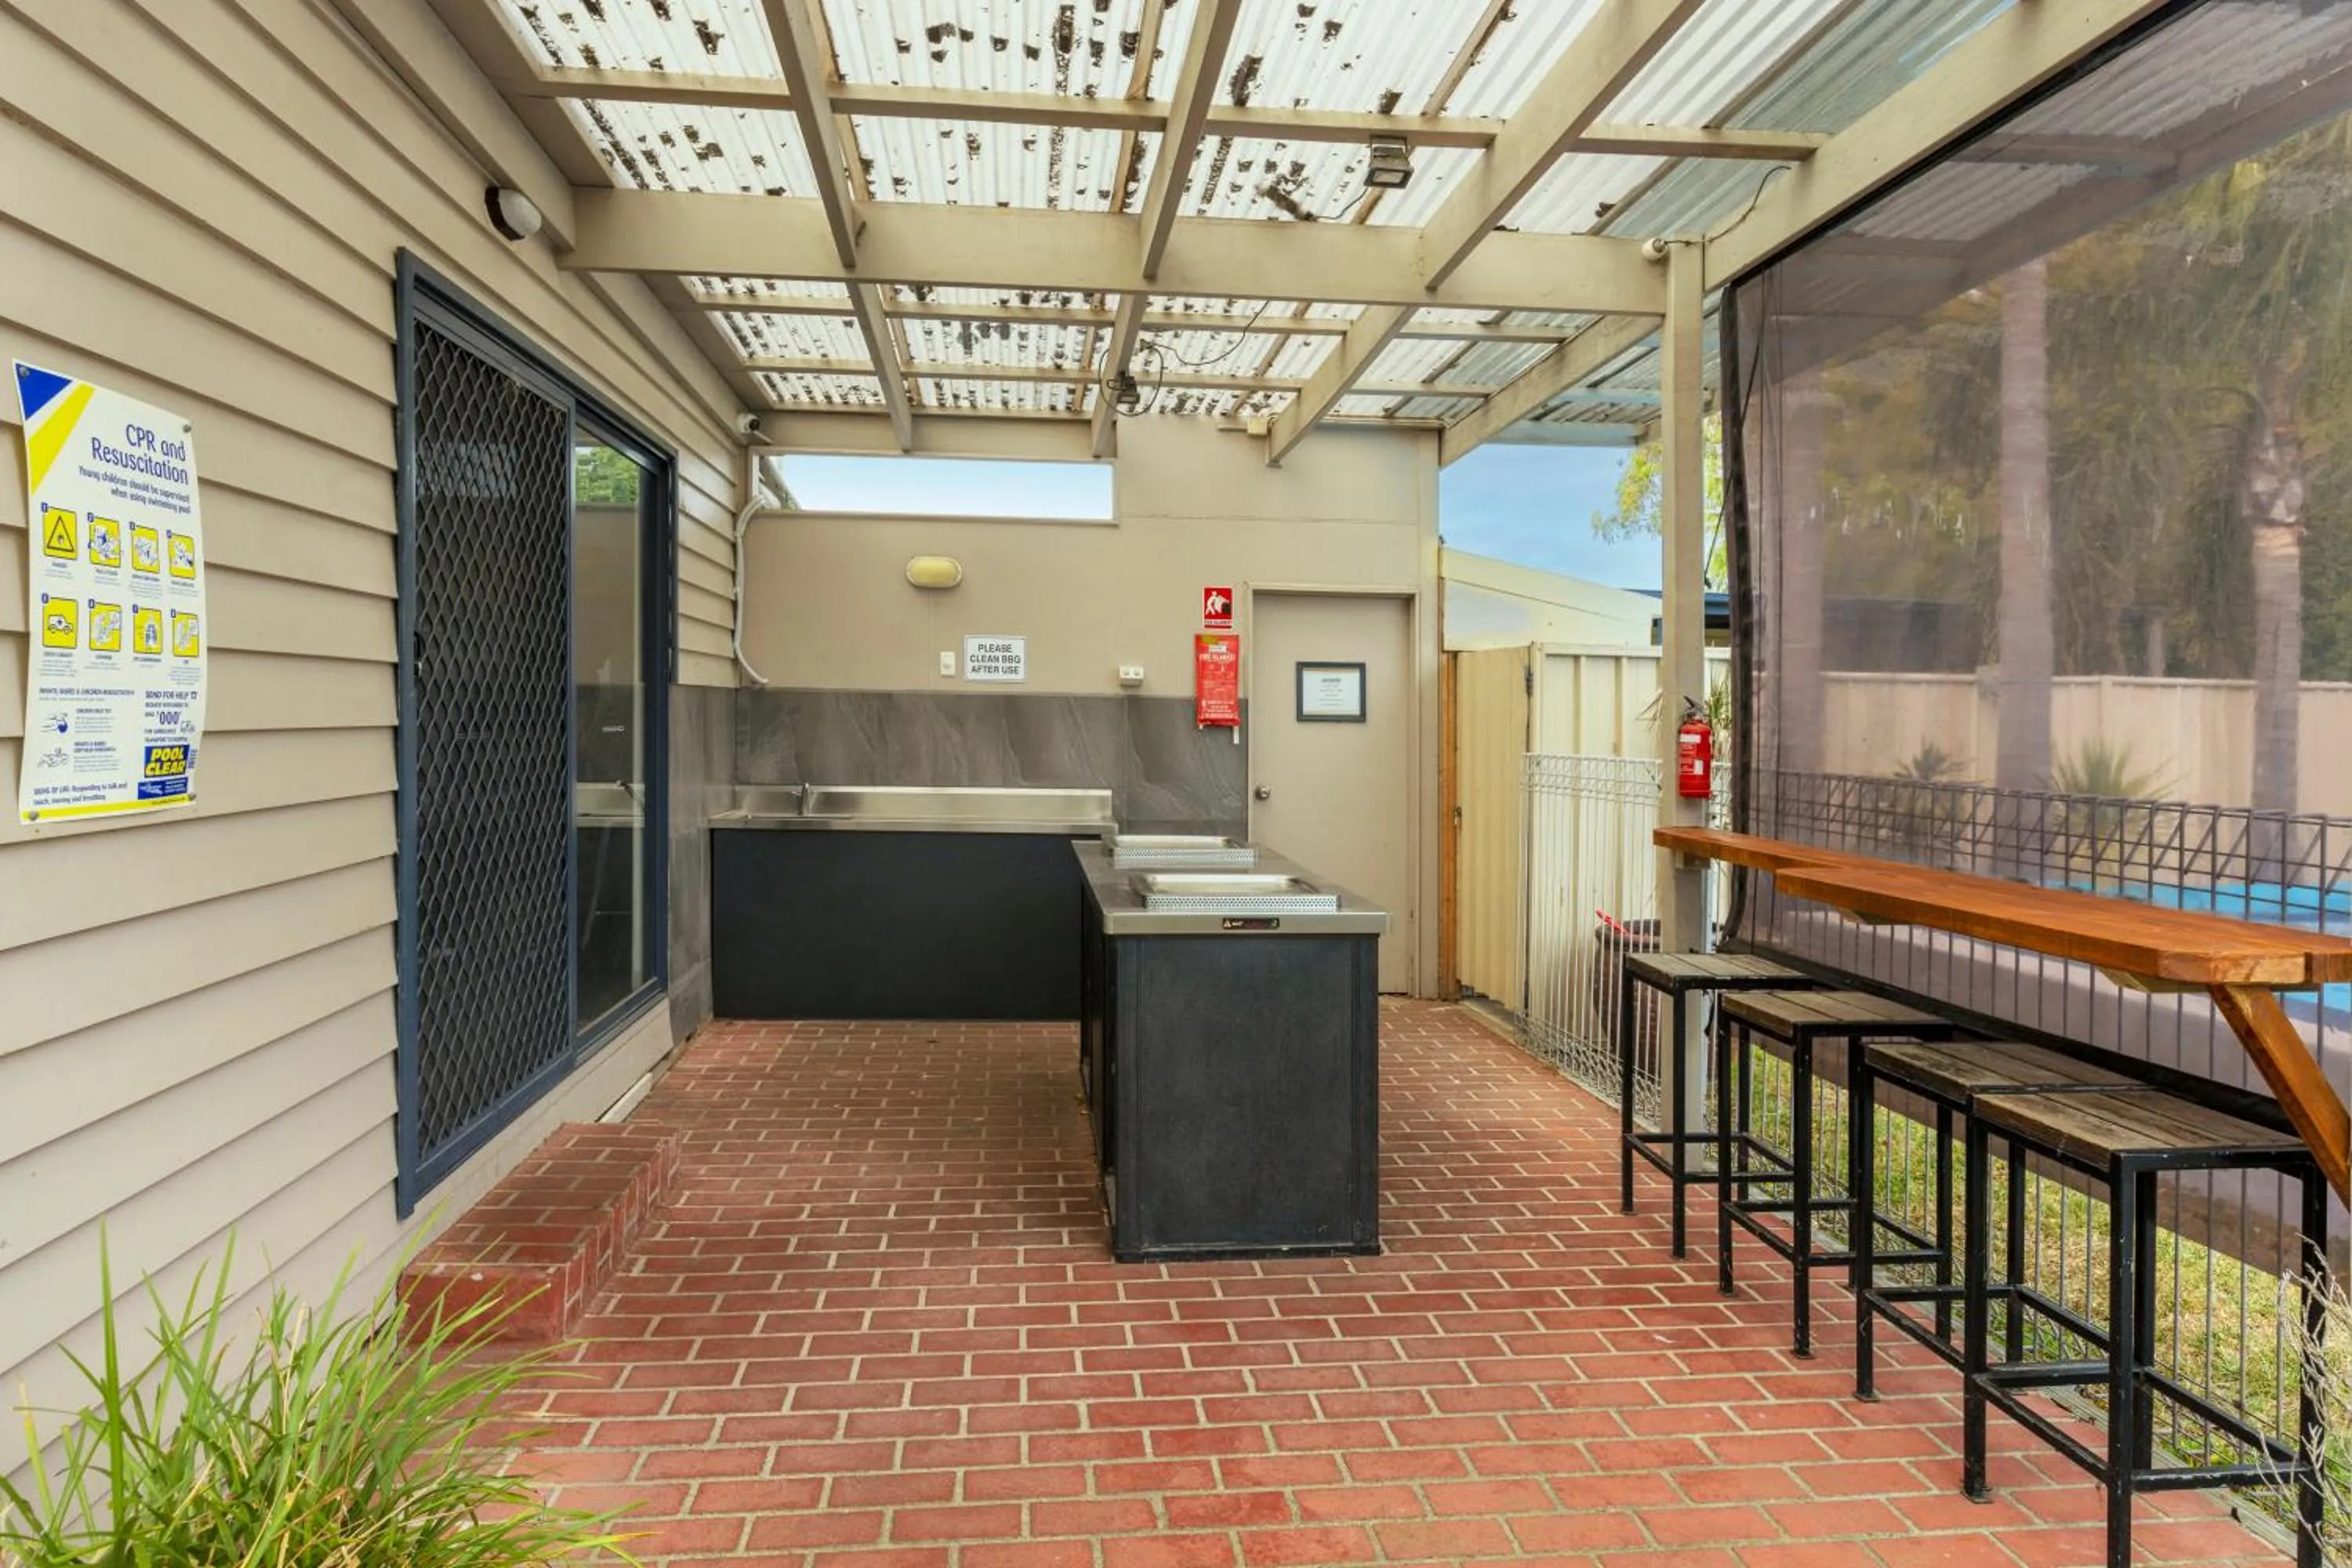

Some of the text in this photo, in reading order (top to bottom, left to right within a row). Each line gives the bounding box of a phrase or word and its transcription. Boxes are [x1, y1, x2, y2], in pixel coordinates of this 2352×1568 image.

[126, 423, 186, 461] CPR and
[92, 437, 188, 485] Resuscitation
[978, 644, 1012, 653] PLEASE
[970, 655, 1021, 664] CLEAN BBQ
[971, 665, 1020, 675] AFTER USE
[163, 691, 174, 701] FOR
[151, 746, 185, 762] POOL
[145, 760, 186, 776] CLEAR
